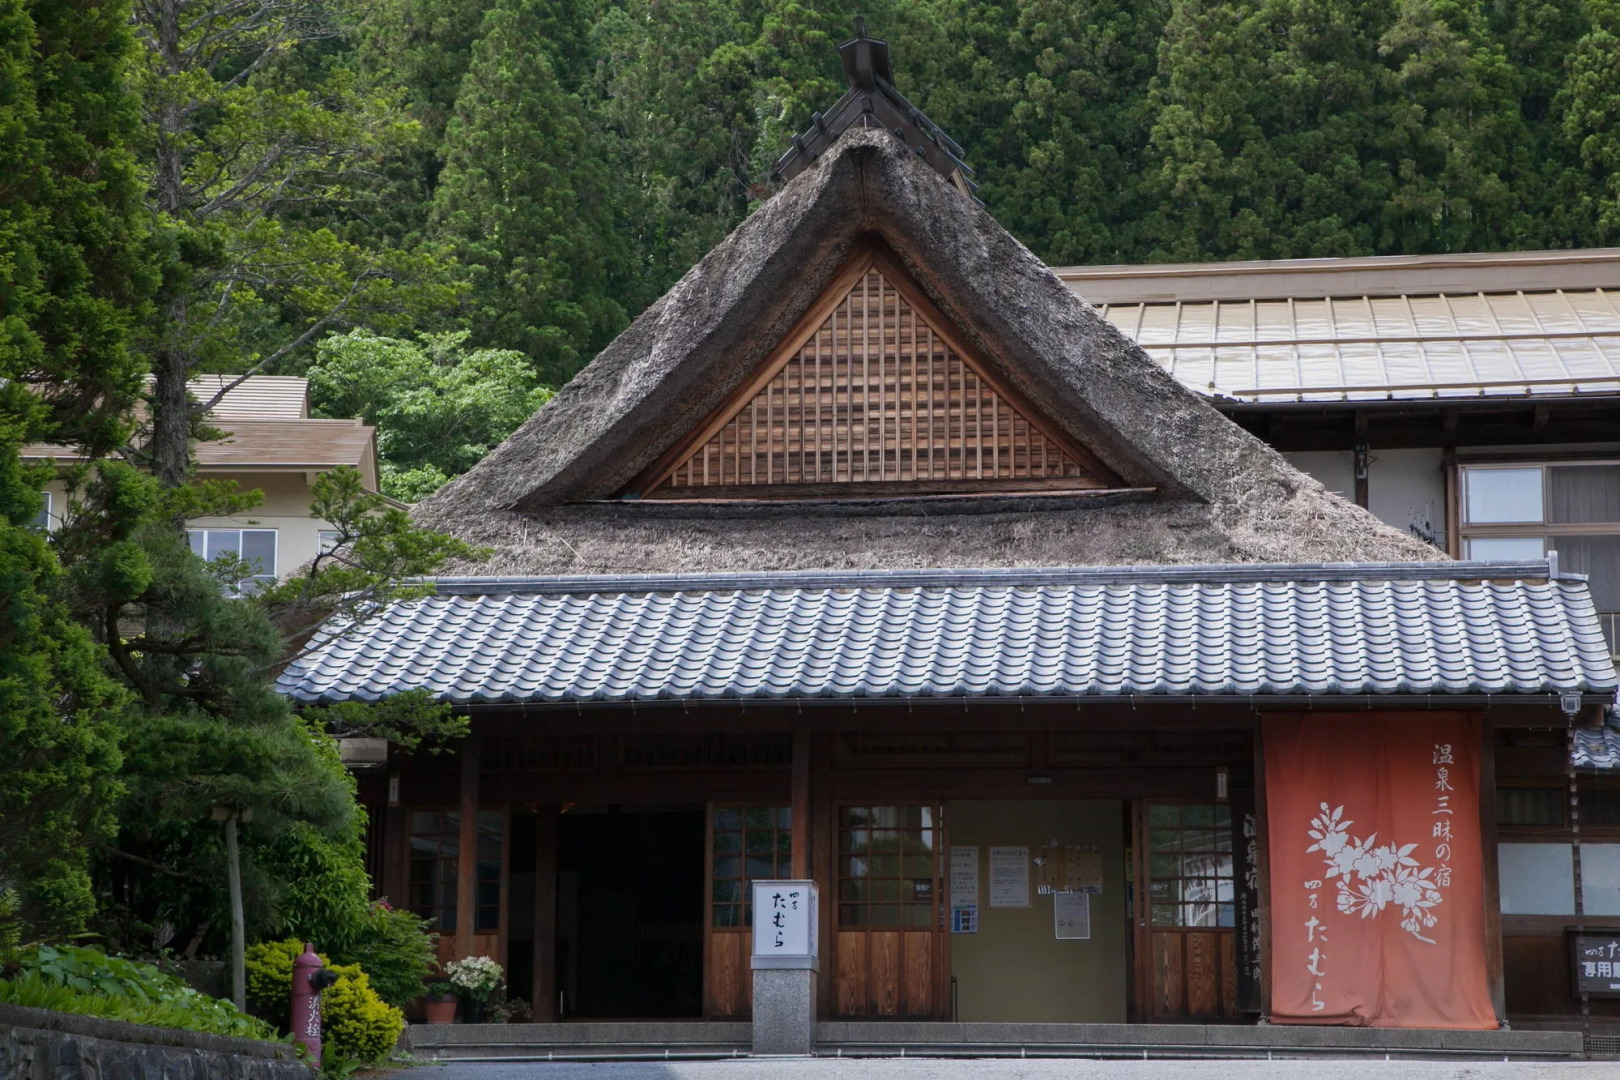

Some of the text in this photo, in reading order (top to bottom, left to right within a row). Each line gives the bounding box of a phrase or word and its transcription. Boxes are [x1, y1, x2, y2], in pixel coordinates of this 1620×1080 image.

[1432, 743, 1455, 888] 温泉三昧の宿
[772, 892, 787, 948] たむら
[1304, 879, 1328, 1011] 四万たむら
[305, 996, 320, 1037] 消火栓
